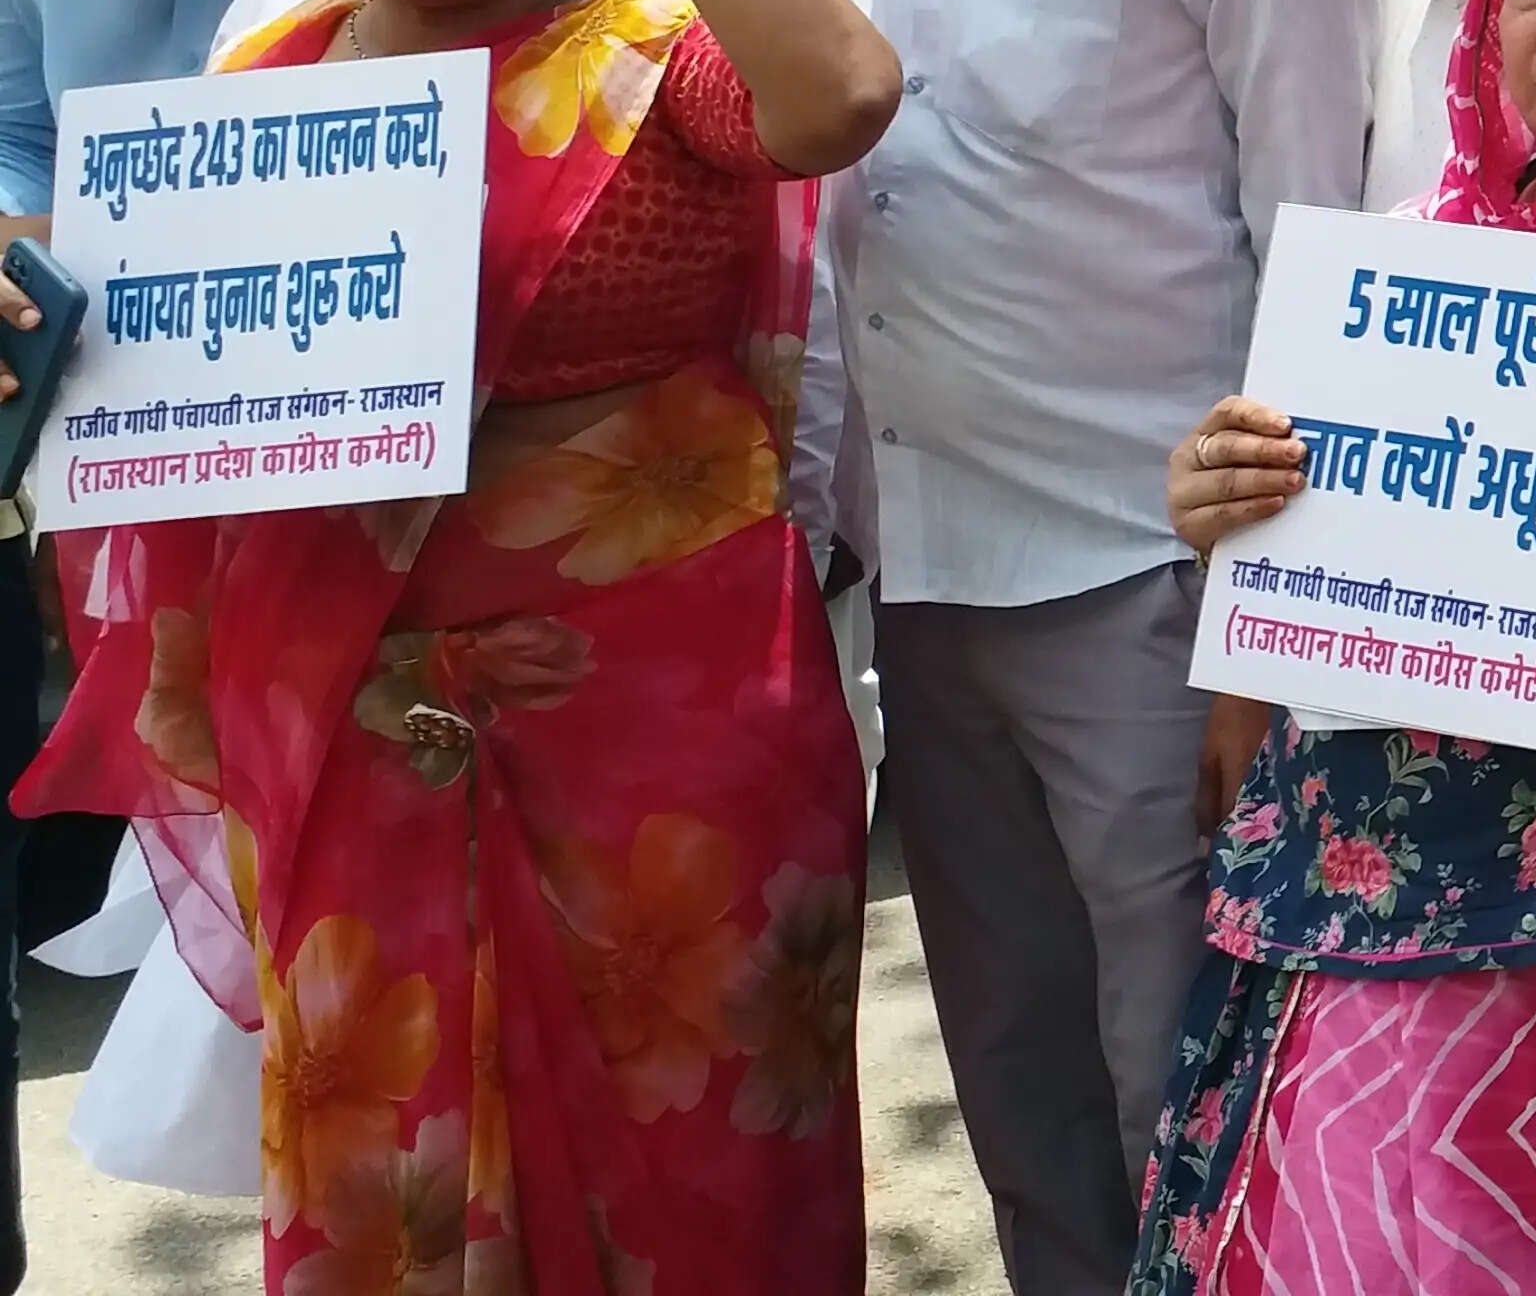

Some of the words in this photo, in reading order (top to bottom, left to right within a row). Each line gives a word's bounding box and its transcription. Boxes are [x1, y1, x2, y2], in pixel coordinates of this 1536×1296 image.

[79, 106, 186, 222] अनुच्छेद
[189, 118, 246, 189] 243
[252, 115, 293, 183] का
[296, 106, 381, 178] पालन
[384, 79, 449, 179] करो,
[105, 258, 200, 347] पंचायत
[202, 263, 282, 361] चुनाव
[347, 230, 406, 322] करो
[1342, 267, 1377, 339] 5
[1383, 274, 1491, 354] साल
[65, 405, 121, 441] राजीव
[124, 401, 169, 435] गांधी
[171, 394, 243, 430] पंचायती
[246, 395, 283, 424] राज
[360, 380, 445, 413] राजस्थान
[67, 451, 191, 504] (राजस्थान
[194, 440, 256, 485] प्रदेश
[261, 431, 343, 477] कांग्रेस
[347, 421, 436, 470] कमेटी)
[1288, 415, 1379, 496] नाव
[1380, 415, 1476, 510] क्यों
[1232, 557, 1283, 595] राजीव
[1283, 564, 1325, 602] गांधी
[1326, 571, 1393, 614] पंचायती
[1394, 587, 1430, 621] राज
[1225, 604, 1339, 665] (राजस्थान
[1338, 626, 1399, 676] प्रदेश
[1401, 640, 1478, 690] कांग्रेस
